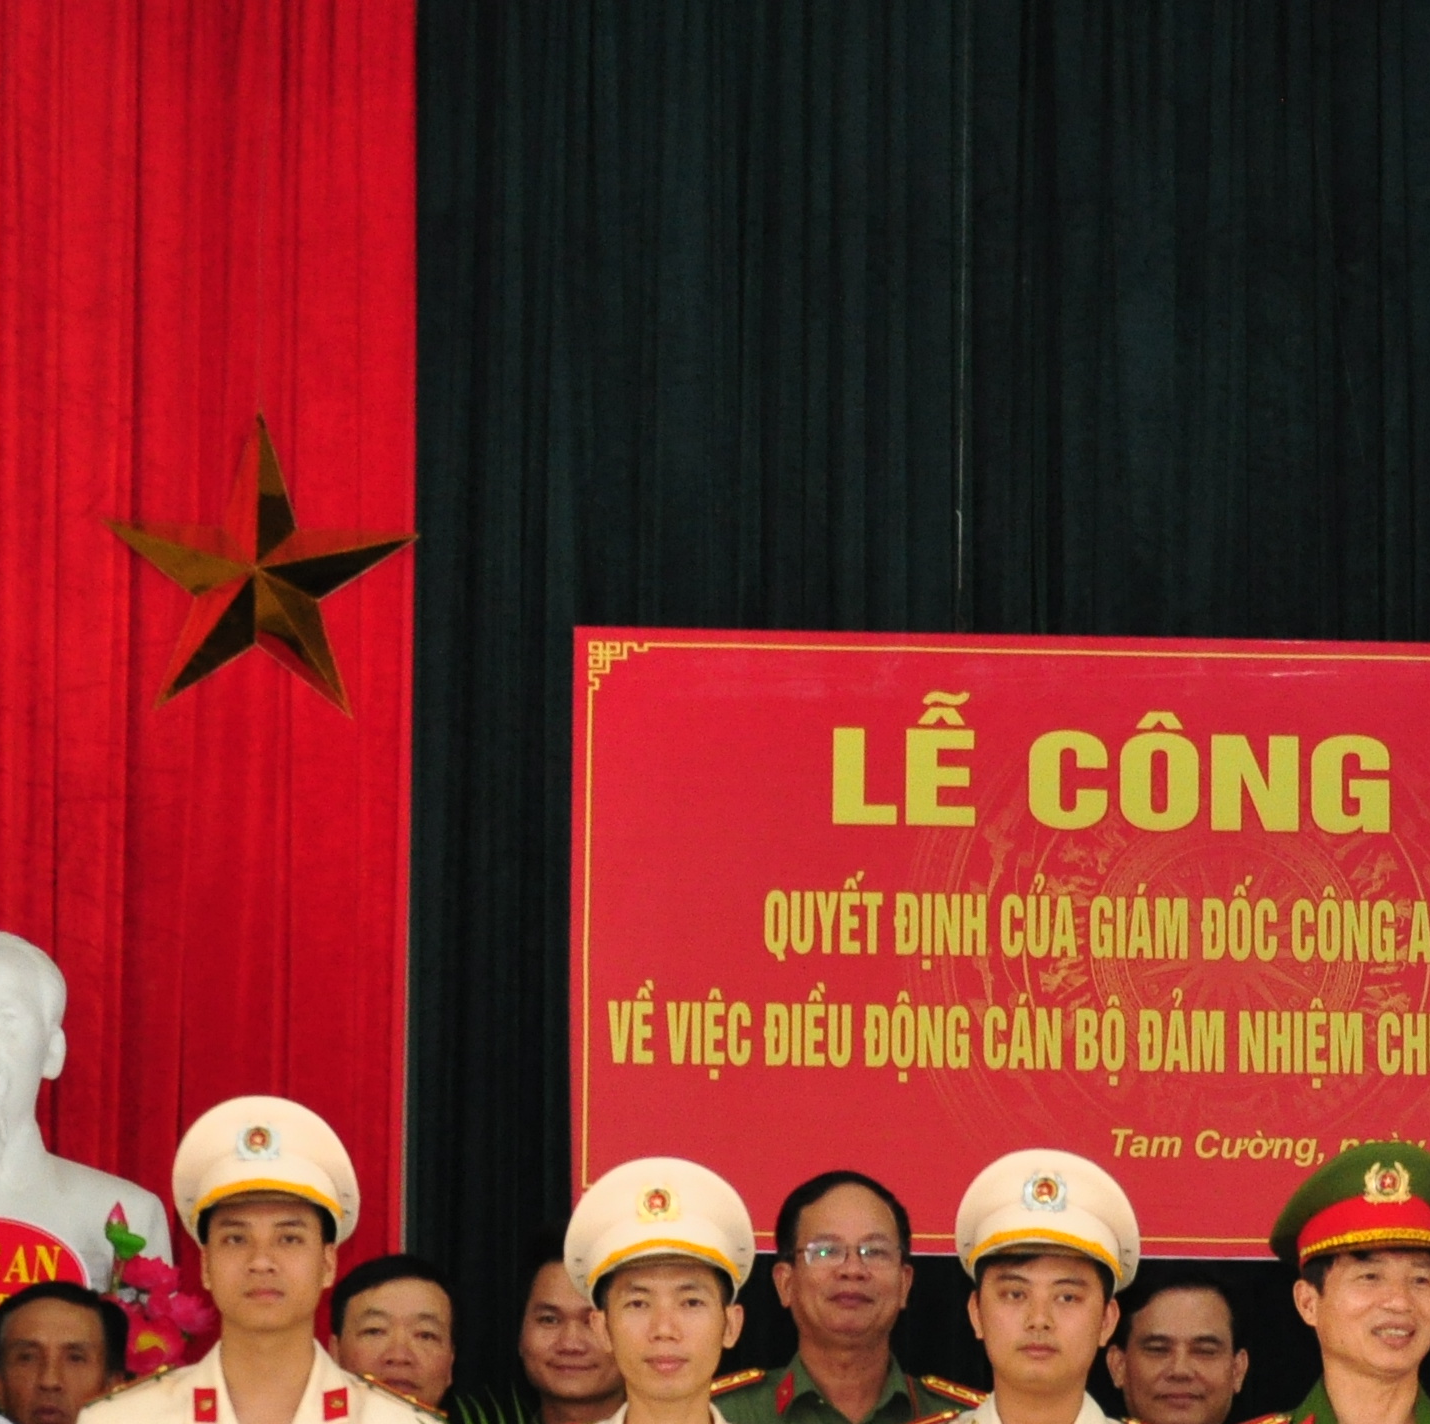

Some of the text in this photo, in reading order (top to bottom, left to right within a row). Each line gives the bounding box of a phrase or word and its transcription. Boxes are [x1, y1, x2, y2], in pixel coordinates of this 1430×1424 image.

[831, 692, 976, 827] LỄ
[1028, 711, 1391, 834] CÔNG
[764, 871, 883, 962] QUYẾT
[894, 892, 988, 970] ĐỊNH
[1000, 873, 1077, 958] CỦA
[1089, 883, 1189, 959] GIÁM
[1201, 876, 1278, 961] ĐỐC
[1291, 886, 1396, 962] CÔNG
[608, 979, 655, 1064] VỀ
[666, 988, 752, 1080] VIỆC
[764, 981, 853, 1068] ĐIỀU
[864, 990, 970, 1083] ĐỘNG
[983, 993, 1062, 1070] CÁN
[1075, 995, 1126, 1086] BỘ
[1137, 987, 1226, 1073] ĐẢM
[1238, 998, 1364, 1089] NHIỆM
[1111, 1128, 1183, 1158] Tam
[1195, 1130, 1325, 1166] Cường,
[3, 1244, 62, 1284] AN
